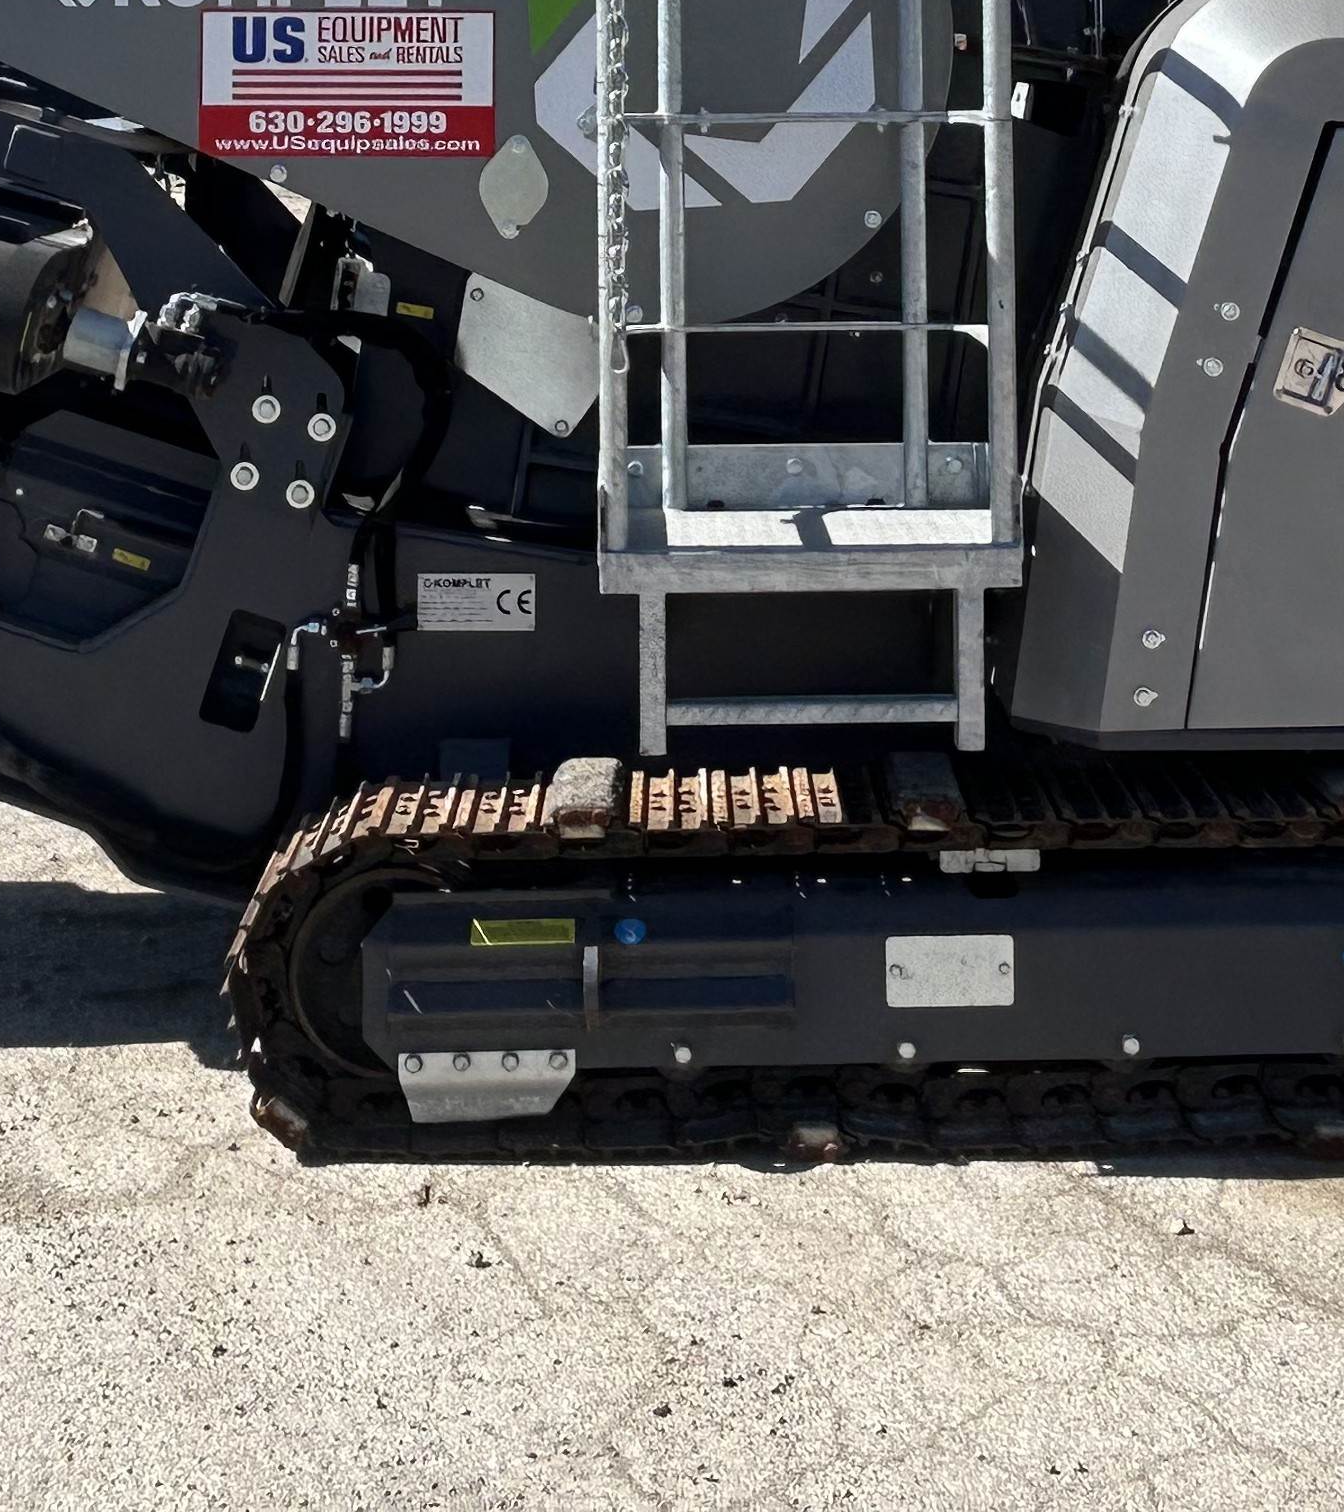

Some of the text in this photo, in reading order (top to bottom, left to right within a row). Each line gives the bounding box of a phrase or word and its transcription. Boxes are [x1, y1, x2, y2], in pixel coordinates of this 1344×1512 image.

[317, 16, 464, 43] EQUIPMENT
[317, 45, 365, 64] SALES
[396, 46, 464, 64] RENTALS
